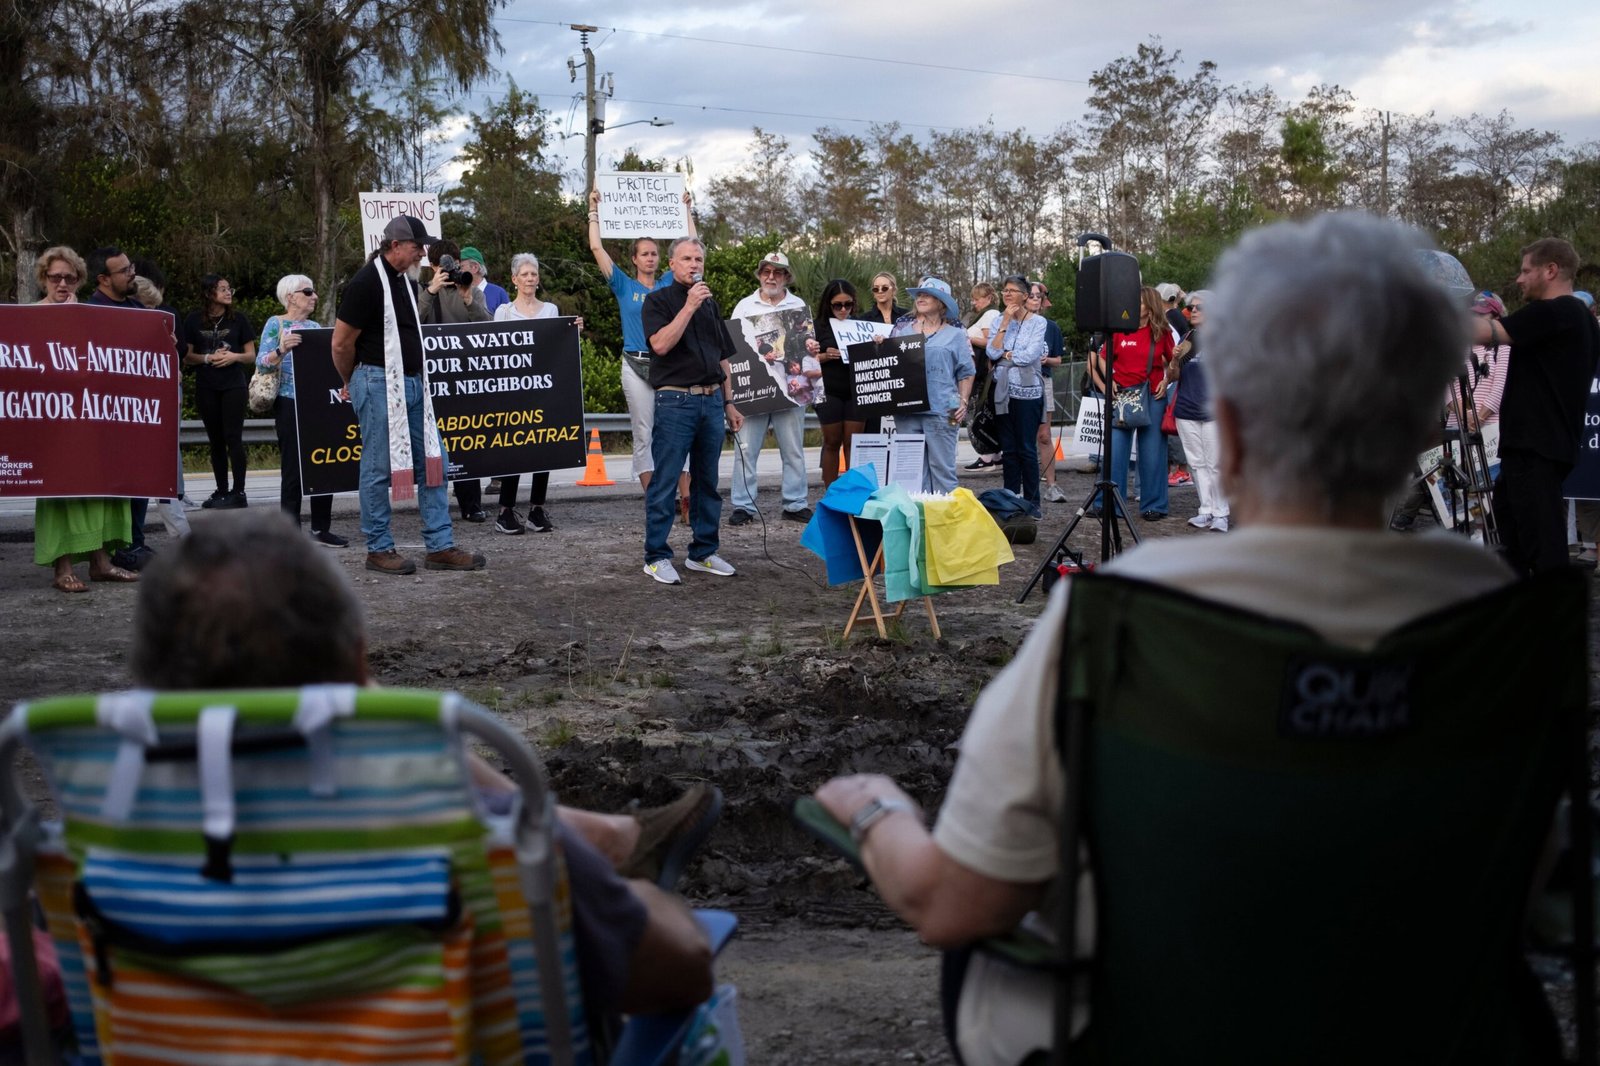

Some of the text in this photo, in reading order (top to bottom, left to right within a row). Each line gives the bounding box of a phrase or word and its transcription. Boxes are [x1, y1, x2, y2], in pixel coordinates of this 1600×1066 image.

[617, 177, 668, 191] PROTECT
[603, 192, 679, 204] HUMAN RIGHTS
[614, 206, 680, 217] NATIVE TRIBES
[604, 219, 683, 231] THE EVERGLADES
[856, 322, 875, 333] NO
[423, 331, 534, 351] OUR WATCH
[838, 331, 873, 343] HUM
[907, 341, 921, 350] AFSC
[0, 341, 171, 379] RAL, UN-AMERICAN
[426, 353, 533, 374] OUR NATION
[729, 359, 751, 374] tand
[854, 356, 899, 372] IMMIGRANTS
[737, 375, 751, 387] for
[855, 369, 891, 383] MAKE OUR
[428, 374, 553, 397] UR NEIGHBORS
[757, 385, 777, 398] unity
[856, 378, 905, 394] COMMUNITIES
[857, 392, 892, 405] STRONGER
[0, 388, 162, 425] IGATOR ALCATRAZ
[436, 409, 544, 432] ABDUCTIONS
[311, 425, 580, 465] CLOS ATOR ALCATRAZ
[1589, 433, 1600, 449] d
